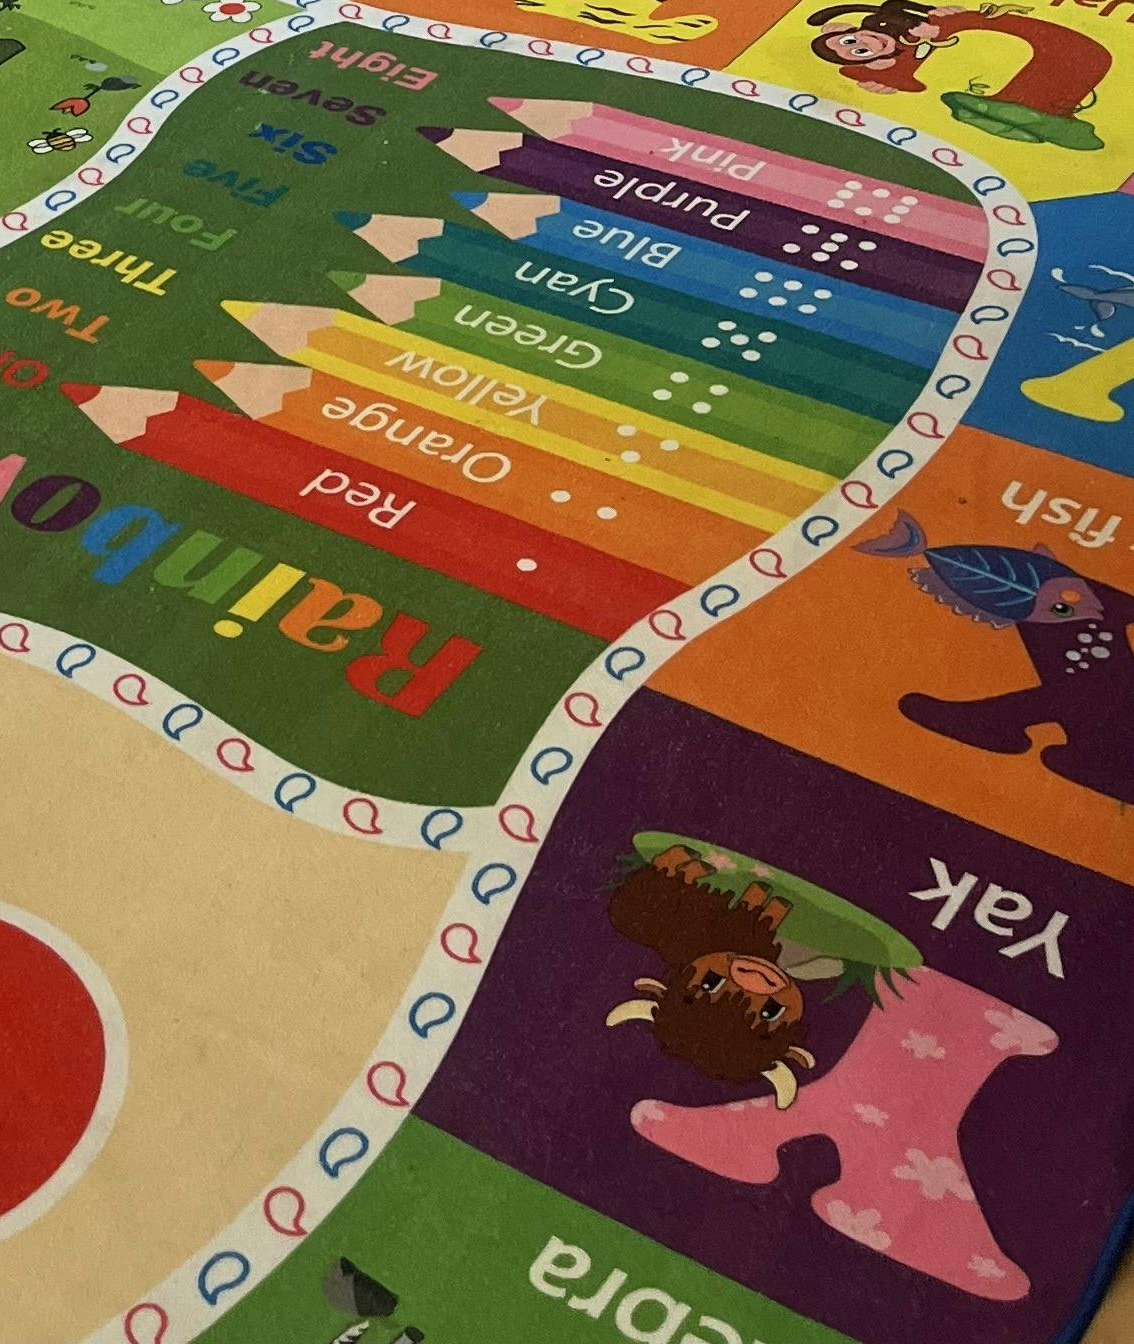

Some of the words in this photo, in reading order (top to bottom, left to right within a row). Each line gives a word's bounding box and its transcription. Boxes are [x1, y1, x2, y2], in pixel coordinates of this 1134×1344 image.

[308, 39, 439, 92] Eight
[237, 69, 390, 128] Seven
[247, 122, 340, 169] Six
[657, 135, 767, 184] Pink
[181, 157, 291, 211] Five
[593, 168, 753, 233] Purple
[112, 196, 240, 253] Four
[572, 219, 682, 270] Blue
[39, 229, 181, 299] Three
[514, 260, 637, 315] Cyan
[4, 285, 113, 345] Two
[453, 303, 604, 371] Green
[384, 348, 543, 428] Yellow
[320, 393, 513, 486] Orange
[300, 467, 420, 532] Red
[1000, 480, 1122, 549] fish
[907, 856, 1072, 980] Yak
